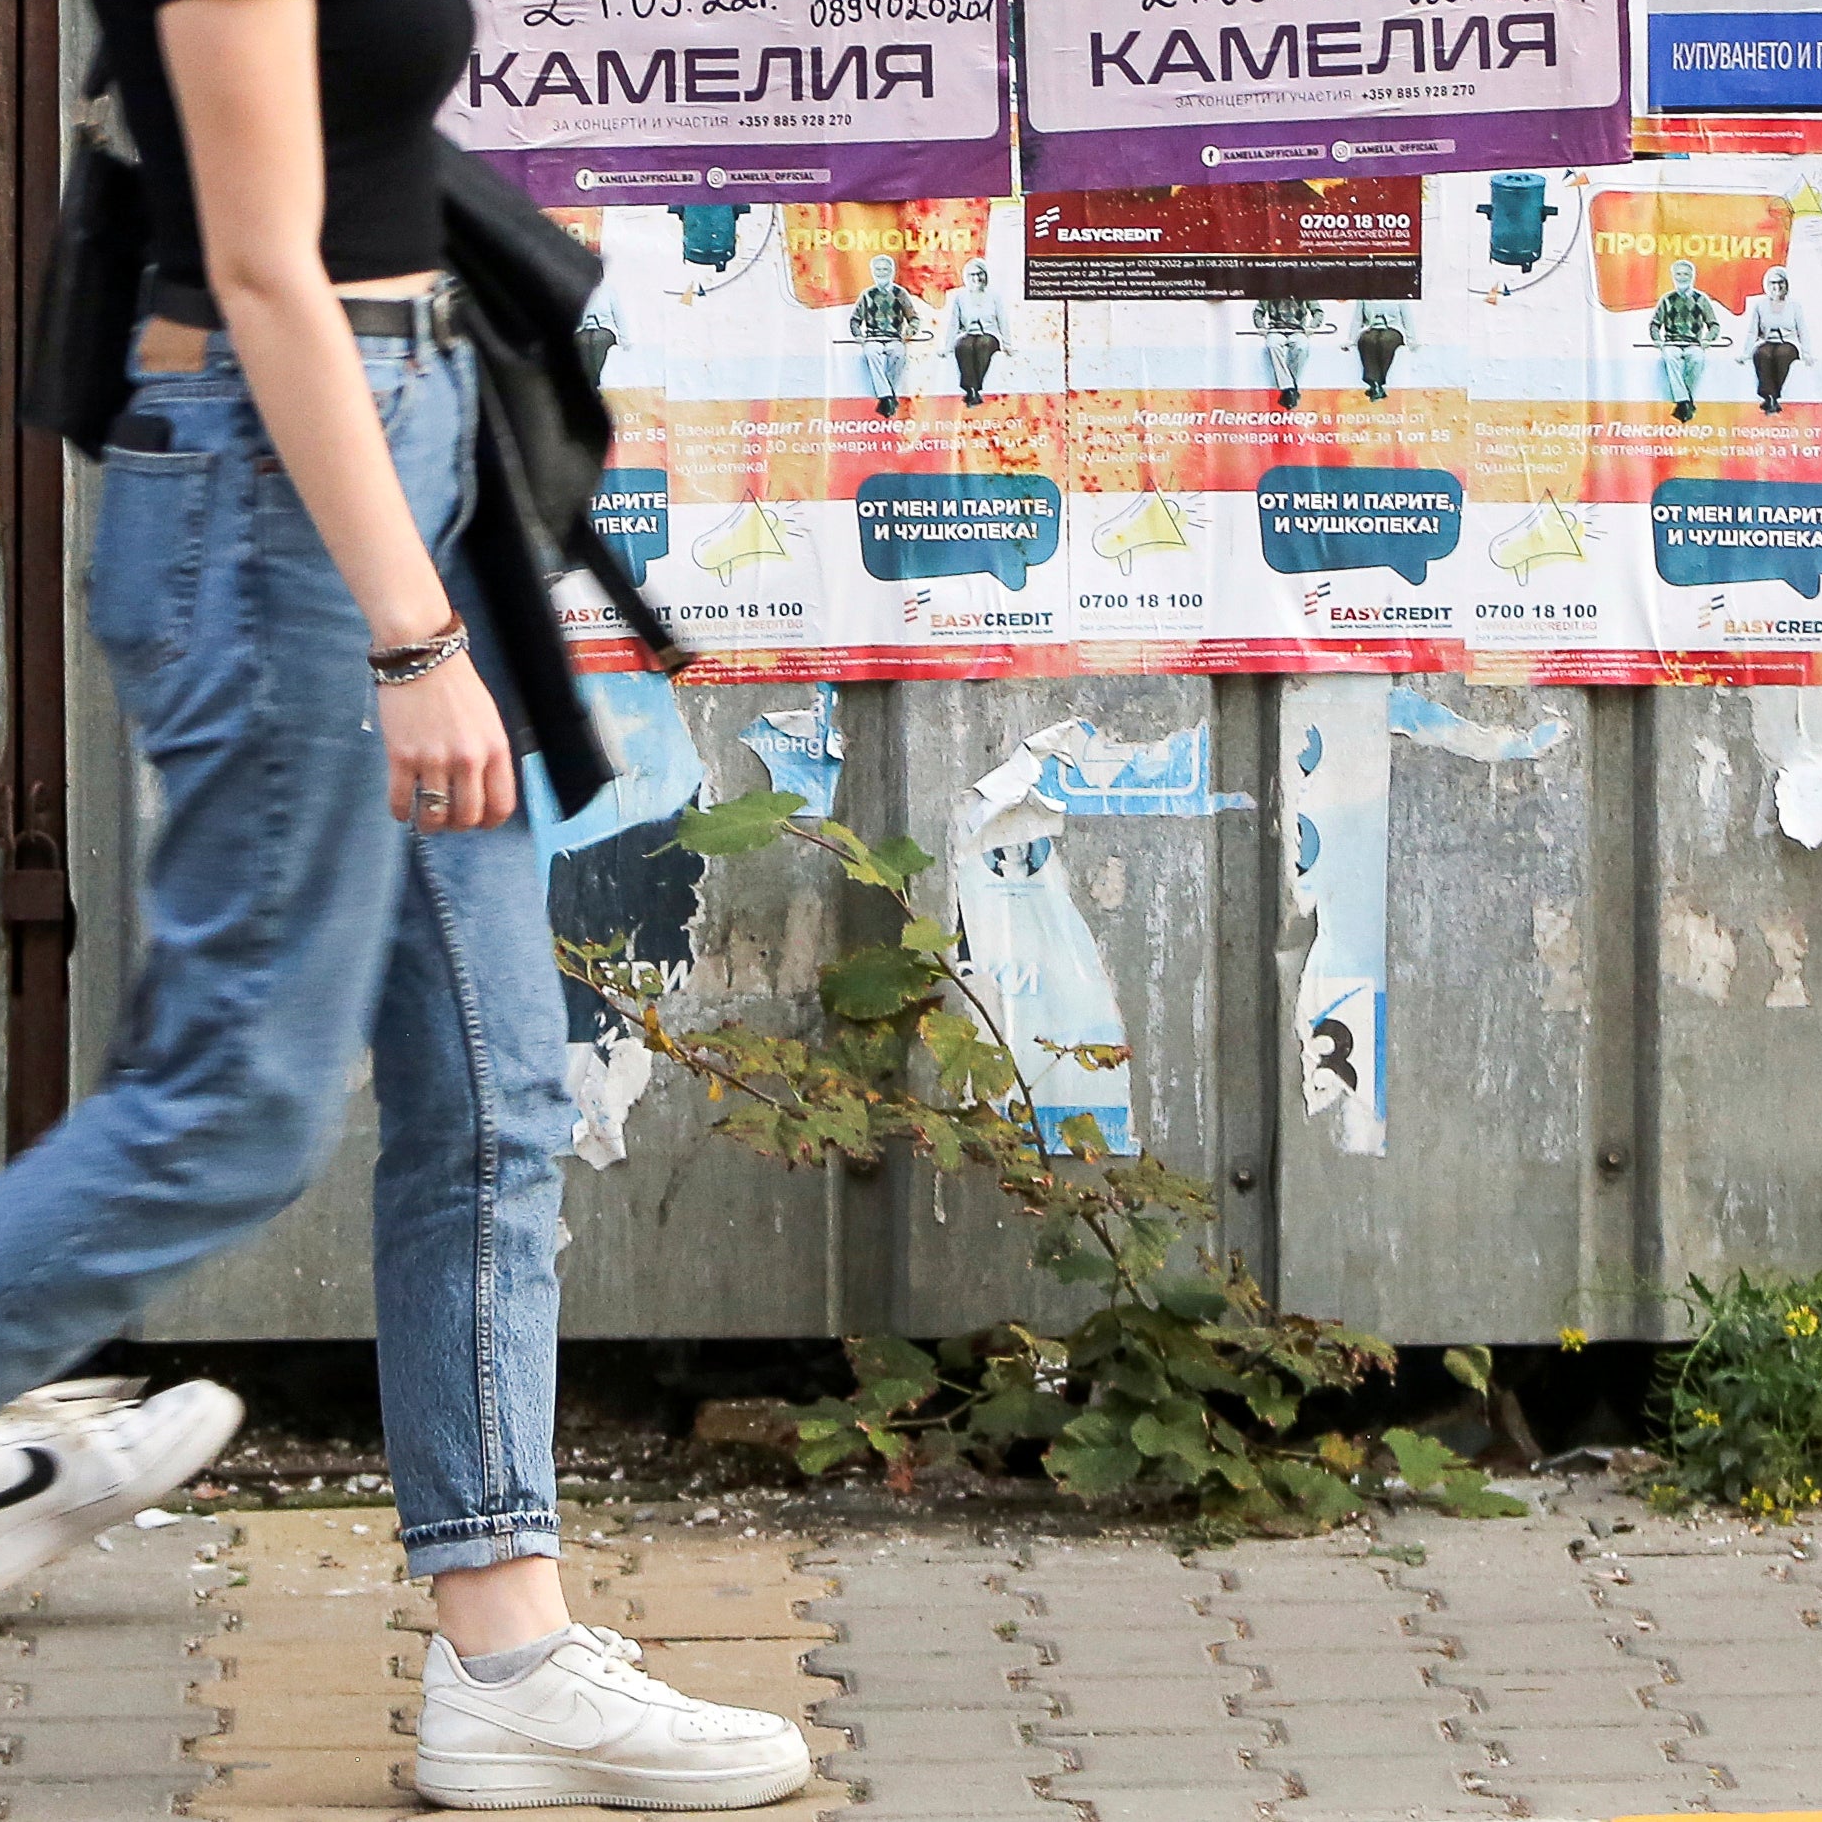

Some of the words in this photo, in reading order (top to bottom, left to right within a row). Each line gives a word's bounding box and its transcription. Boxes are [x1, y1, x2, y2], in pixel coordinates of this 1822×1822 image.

[1090, 12, 1558, 87] КАМЕЛИЯ
[1672, 42, 1791, 71] КУПУВАНЕТО
[1797, 42, 1810, 69] И
[469, 43, 935, 109] КАМЕЛИЯ
[1362, 89, 1393, 102] +359
[1398, 88, 1422, 101] 885
[1425, 86, 1448, 100] 928
[1452, 84, 1476, 98] 270
[1057, 227, 1163, 243] EASYCREDIT
[859, 500, 887, 518] ОТ
[892, 499, 939, 518] МЕН
[944, 501, 958, 517] И
[962, 498, 1054, 520] ПАРИТЕ,
[874, 523, 889, 541] И
[893, 522, 1038, 541] ЧУШКОПЕКА!
[679, 602, 727, 620] 0700
[735, 603, 759, 618] 18
[765, 602, 803, 617] 100
[930, 612, 1053, 628] EASYCREDIT
